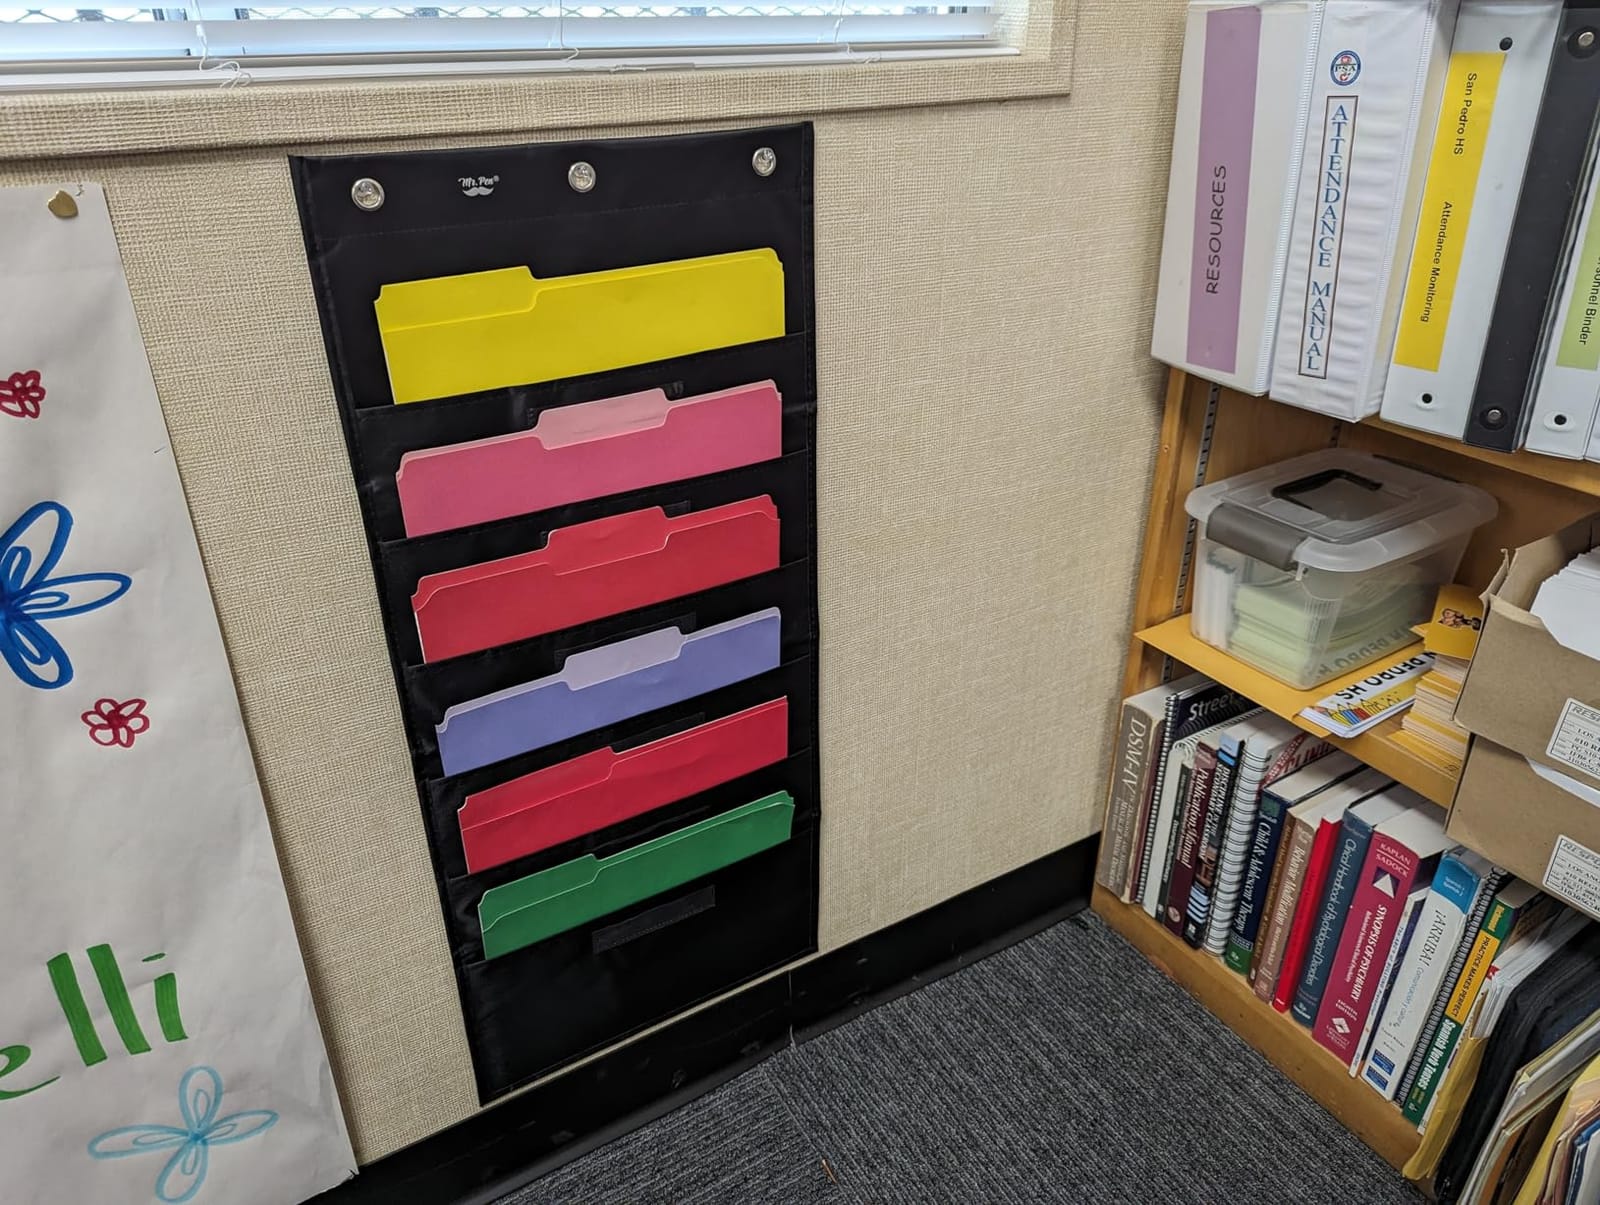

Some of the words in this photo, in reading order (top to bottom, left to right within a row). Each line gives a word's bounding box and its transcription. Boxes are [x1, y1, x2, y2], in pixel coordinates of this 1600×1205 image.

[1465, 73, 1478, 95] San
[1456, 99, 1473, 136] Pedro
[1453, 137, 1464, 155] HS
[458, 177, 478, 188] Mr.
[1317, 104, 1348, 268] ATTENDANCE
[1206, 165, 1227, 294] RESOURCES
[1432, 201, 1453, 264] Attendance
[1420, 266, 1441, 323] Monitoring
[1306, 280, 1331, 371] MANUAL
[1579, 308, 1597, 346] Binder
[1122, 718, 1146, 795] DSM-IV
[1188, 768, 1208, 827] Publication
[1206, 763, 1224, 811] SECONDARY
[1215, 767, 1230, 813] DISCIPLINE
[1181, 826, 1199, 868] Manual
[1198, 812, 1214, 859] CLASSROOM
[1254, 821, 1272, 849] Child
[1340, 838, 1356, 867] Clinical
[1380, 842, 1412, 865] KAPLAN
[1242, 854, 1264, 901] Adolescent
[1288, 845, 1305, 880] Behavior
[1375, 853, 1408, 878] SADOCK
[1275, 880, 1296, 927] Modification
[1329, 865, 1348, 904] Handbook
[1234, 900, 1253, 934] Therapy
[1312, 911, 1336, 956] Psychological
[1368, 905, 1387, 946] SYNOPSIS
[1364, 944, 1374, 958] OF
[1423, 910, 1446, 967] ¡ARRIBA!
[1474, 936, 1490, 967] PRACTICE
[1306, 953, 1323, 986] Disorders
[1350, 956, 1370, 1004] PSYCHIATRY
[1464, 966, 1477, 989] MAKES
[1451, 989, 1468, 1018] PERFECT
[1435, 1018, 1456, 1050] Spanish
[1427, 1048, 1444, 1067] Verb
[1417, 1064, 1437, 1090] Tenses
